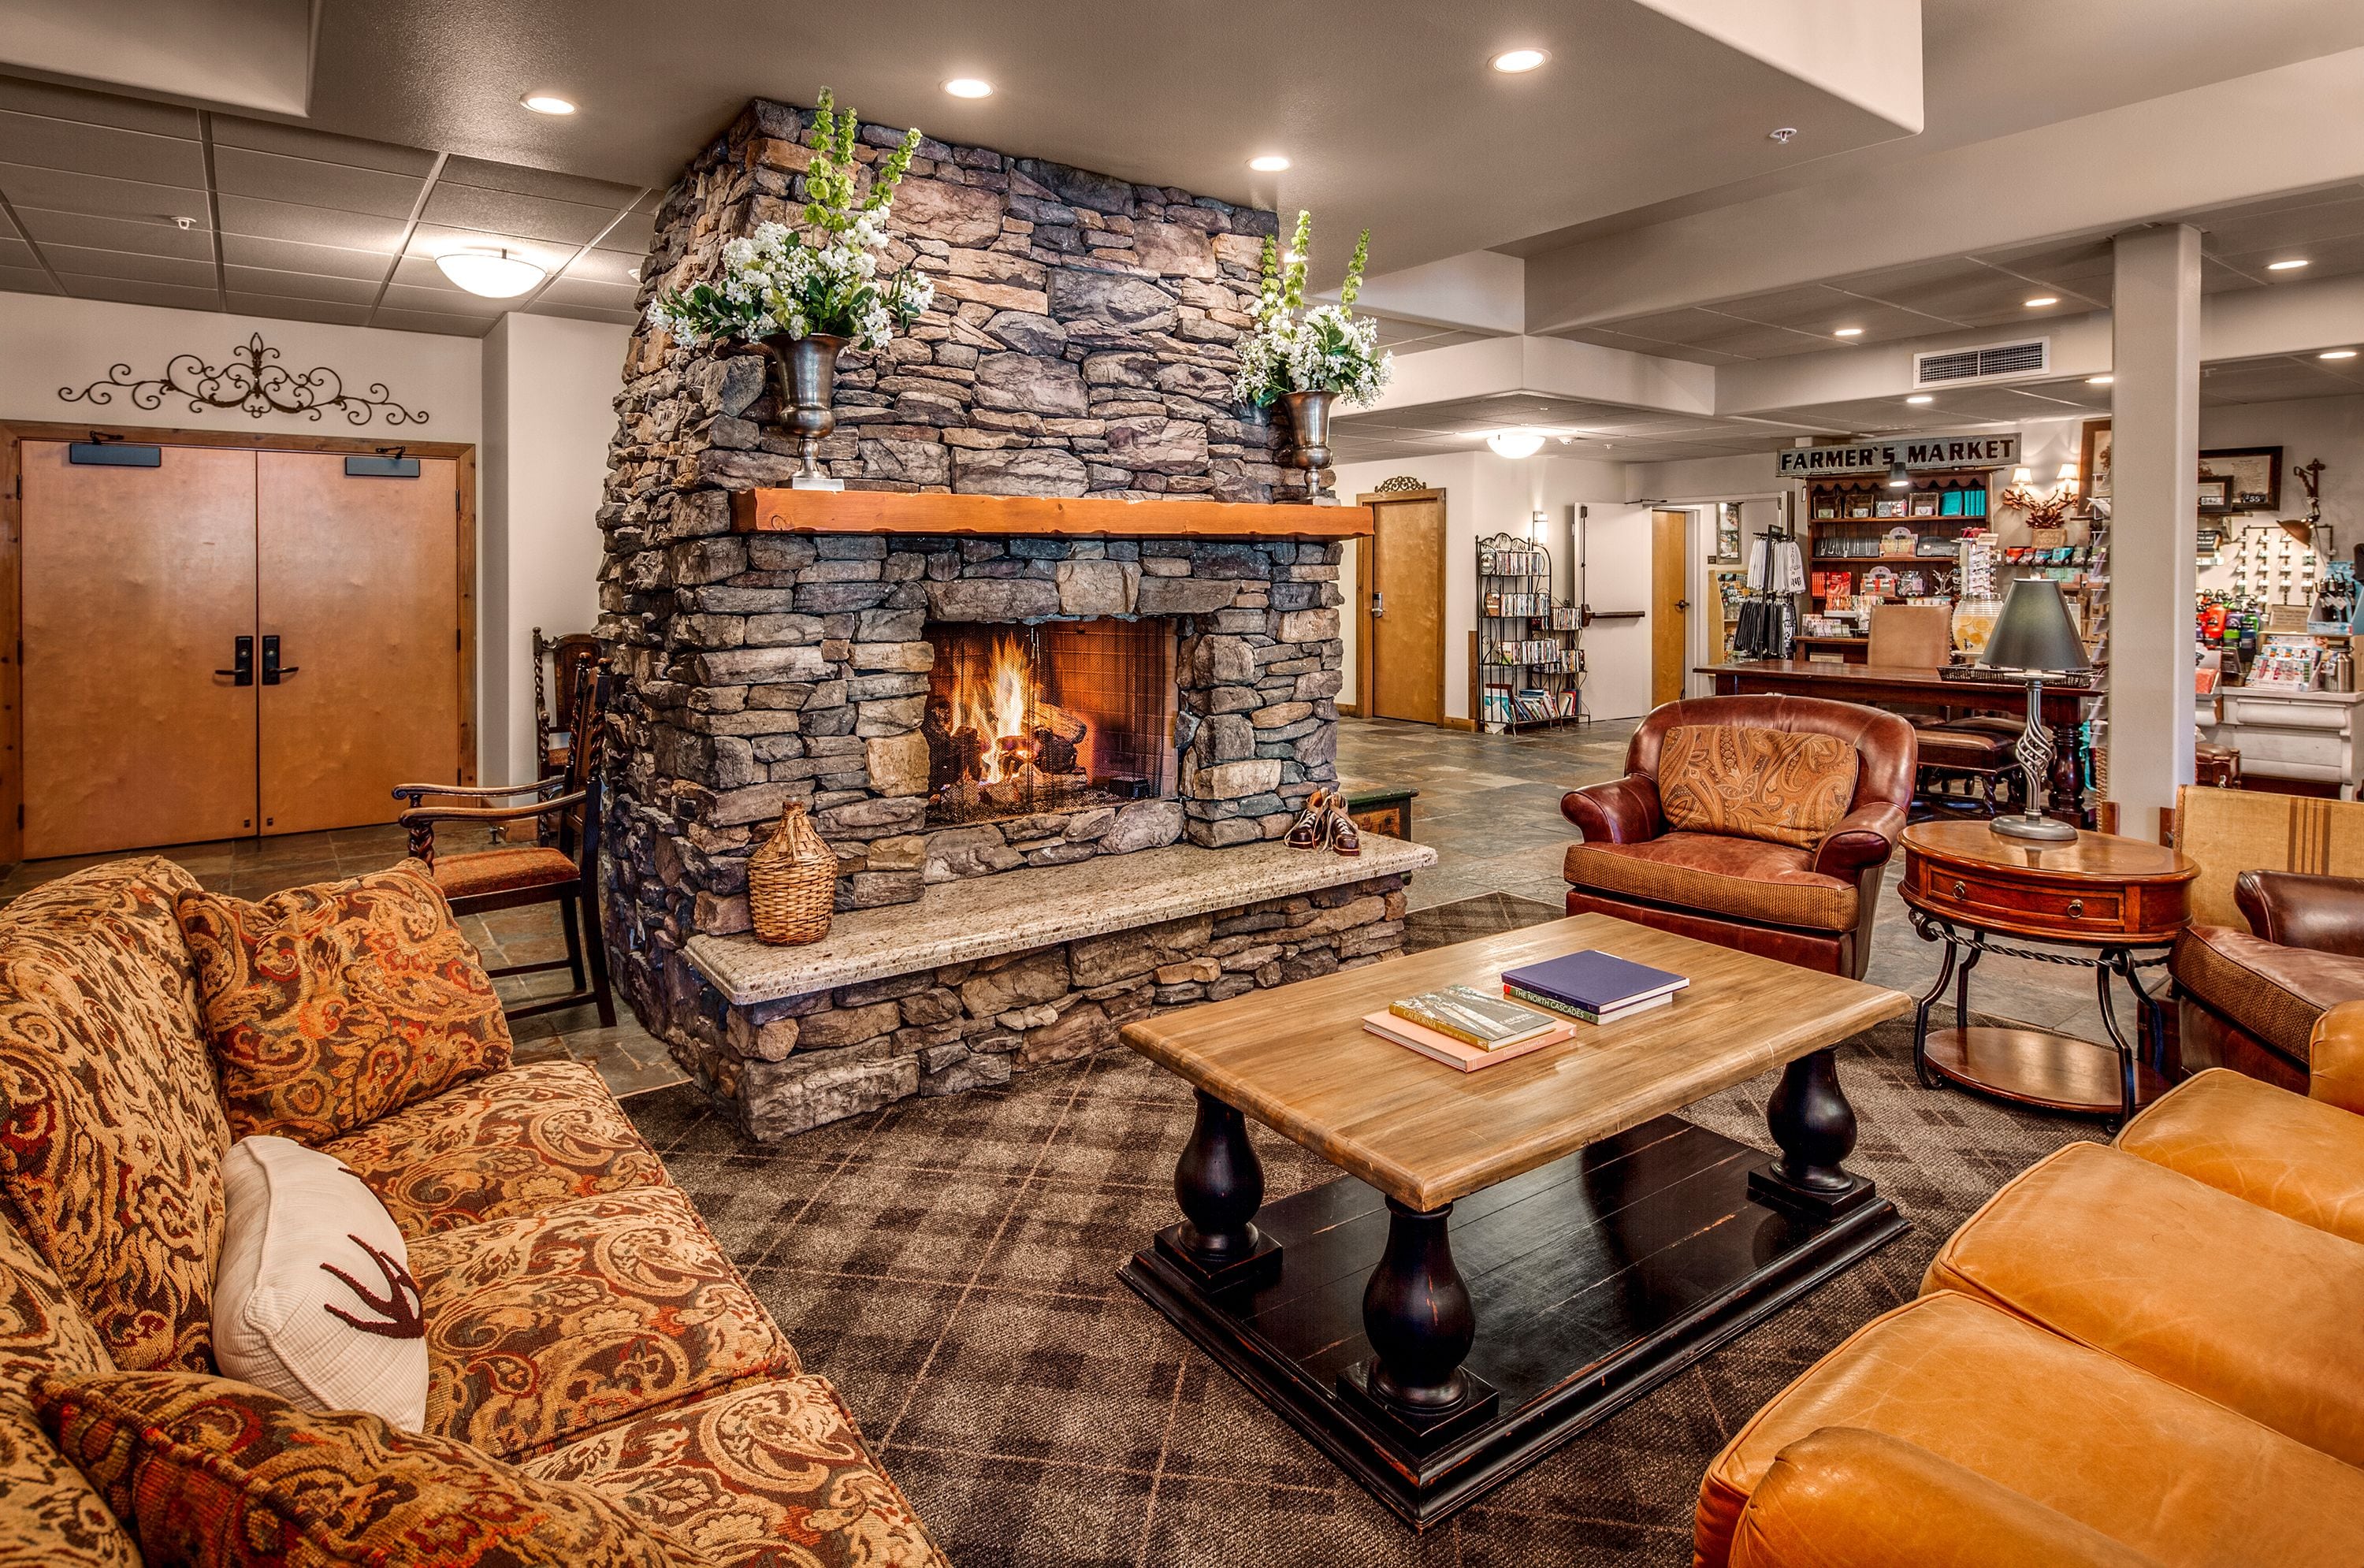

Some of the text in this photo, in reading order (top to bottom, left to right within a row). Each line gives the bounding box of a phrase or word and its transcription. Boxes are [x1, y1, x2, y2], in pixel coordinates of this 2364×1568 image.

[1907, 439, 2014, 463] MARKET
[1515, 989, 1585, 1018] THE NORTH CASCADES
[1403, 1010, 1437, 1030] CALIFORNIA
